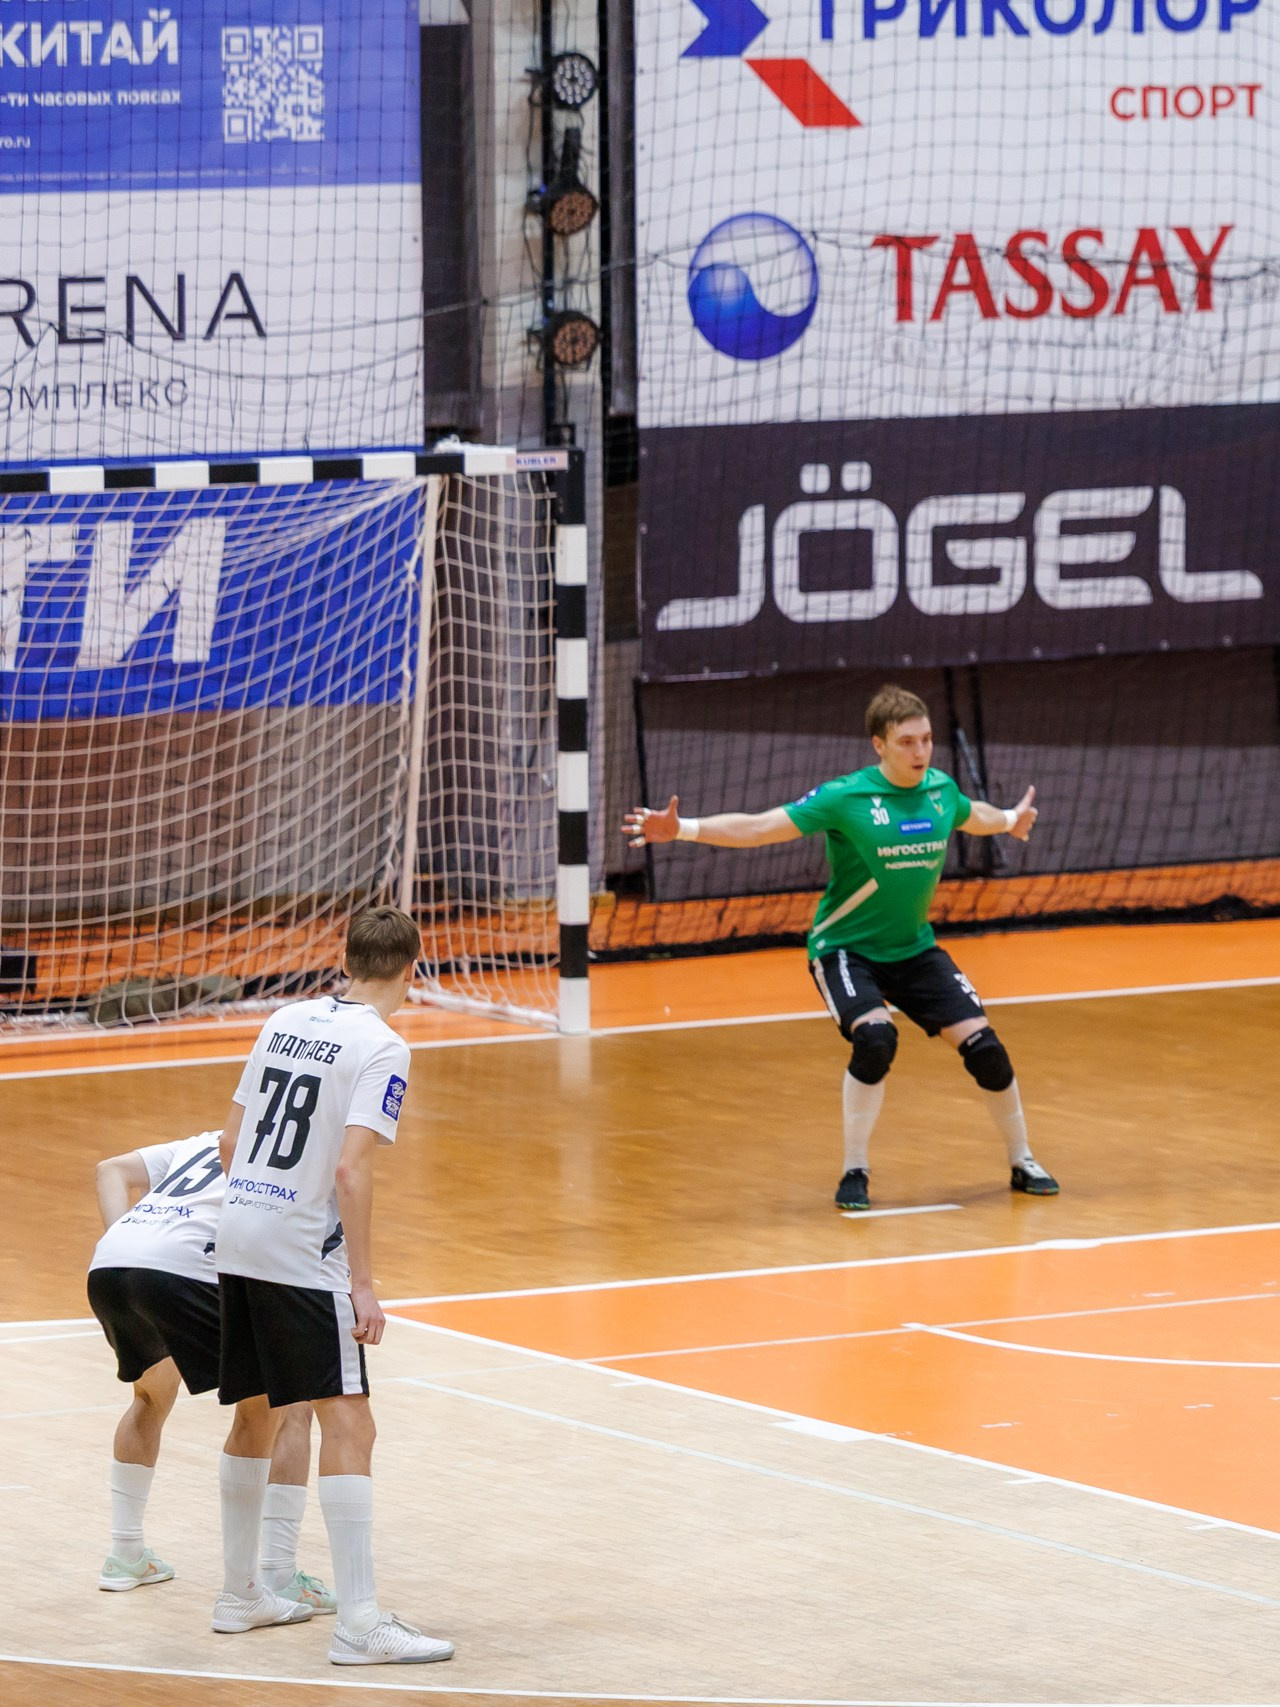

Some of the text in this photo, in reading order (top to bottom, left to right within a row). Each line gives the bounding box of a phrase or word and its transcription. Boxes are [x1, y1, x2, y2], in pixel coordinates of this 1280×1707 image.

[0, 8, 179, 68] КИТАЙ
[1109, 83, 1263, 121] СПОРТ
[871, 223, 1236, 323] TASSAY
[656, 461, 1264, 631] JÖGEL
[870, 807, 890, 826] 30
[267, 1032, 343, 1065] МАМАЕВ
[248, 1066, 322, 1170] 78
[229, 1177, 298, 1202] ИНГОССТРАХ
